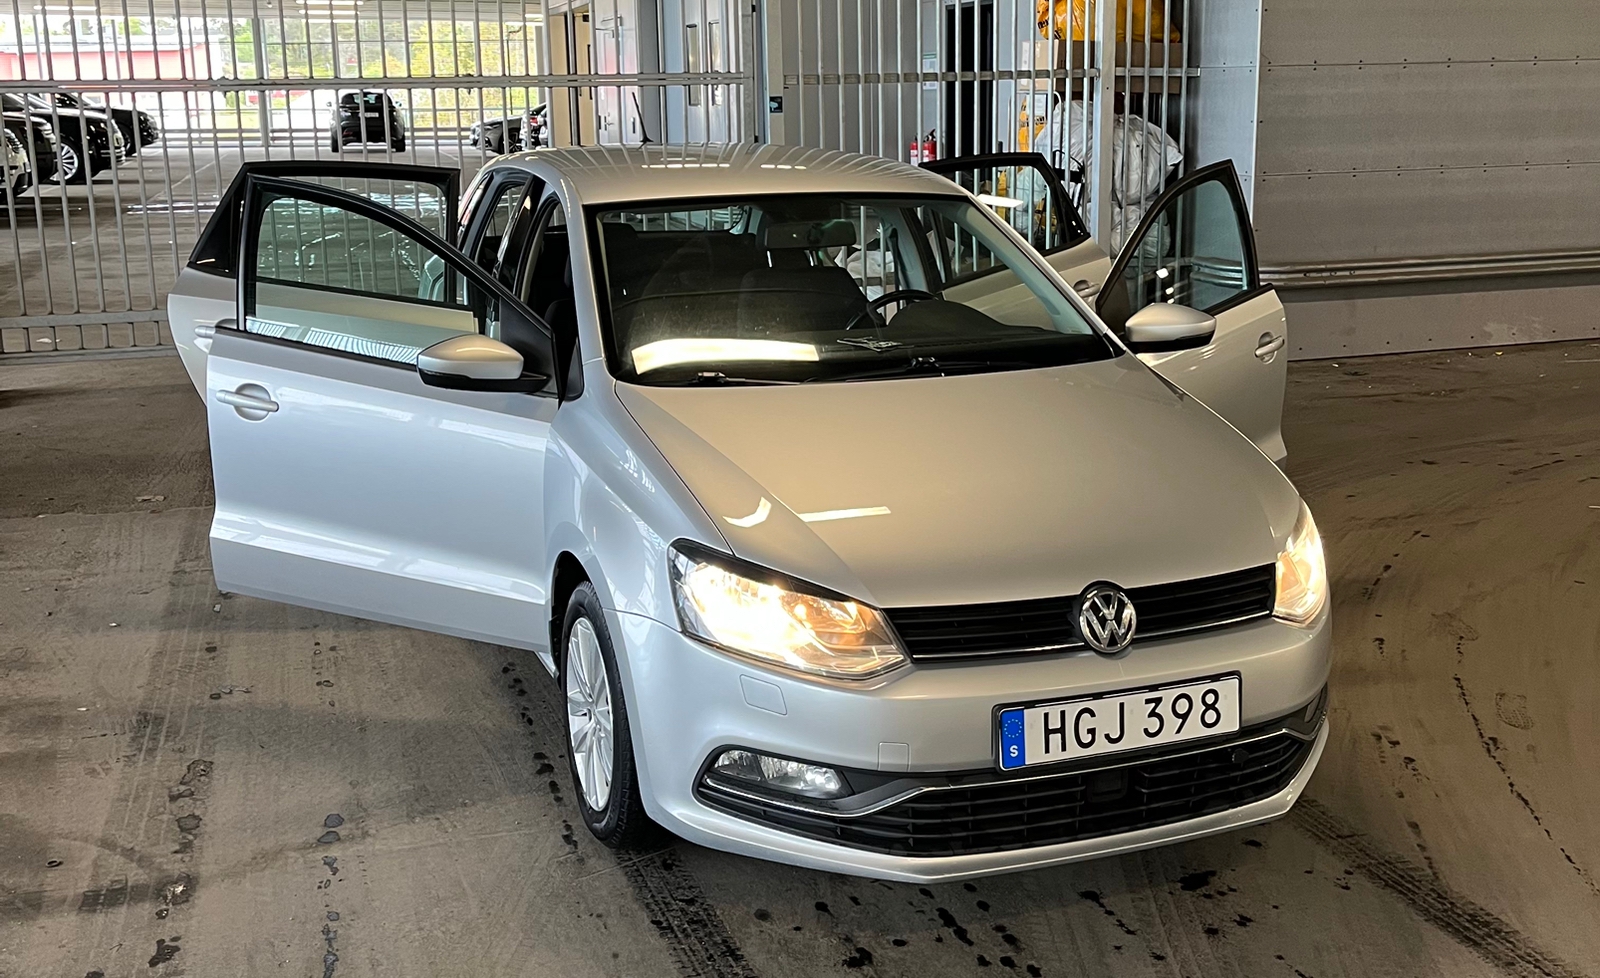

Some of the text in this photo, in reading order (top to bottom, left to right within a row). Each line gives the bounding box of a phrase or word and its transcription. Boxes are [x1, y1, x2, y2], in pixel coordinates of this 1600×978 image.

[1081, 590, 1135, 651] VW
[1009, 745, 1019, 757] S
[1043, 688, 1222, 754] HGJ 398
